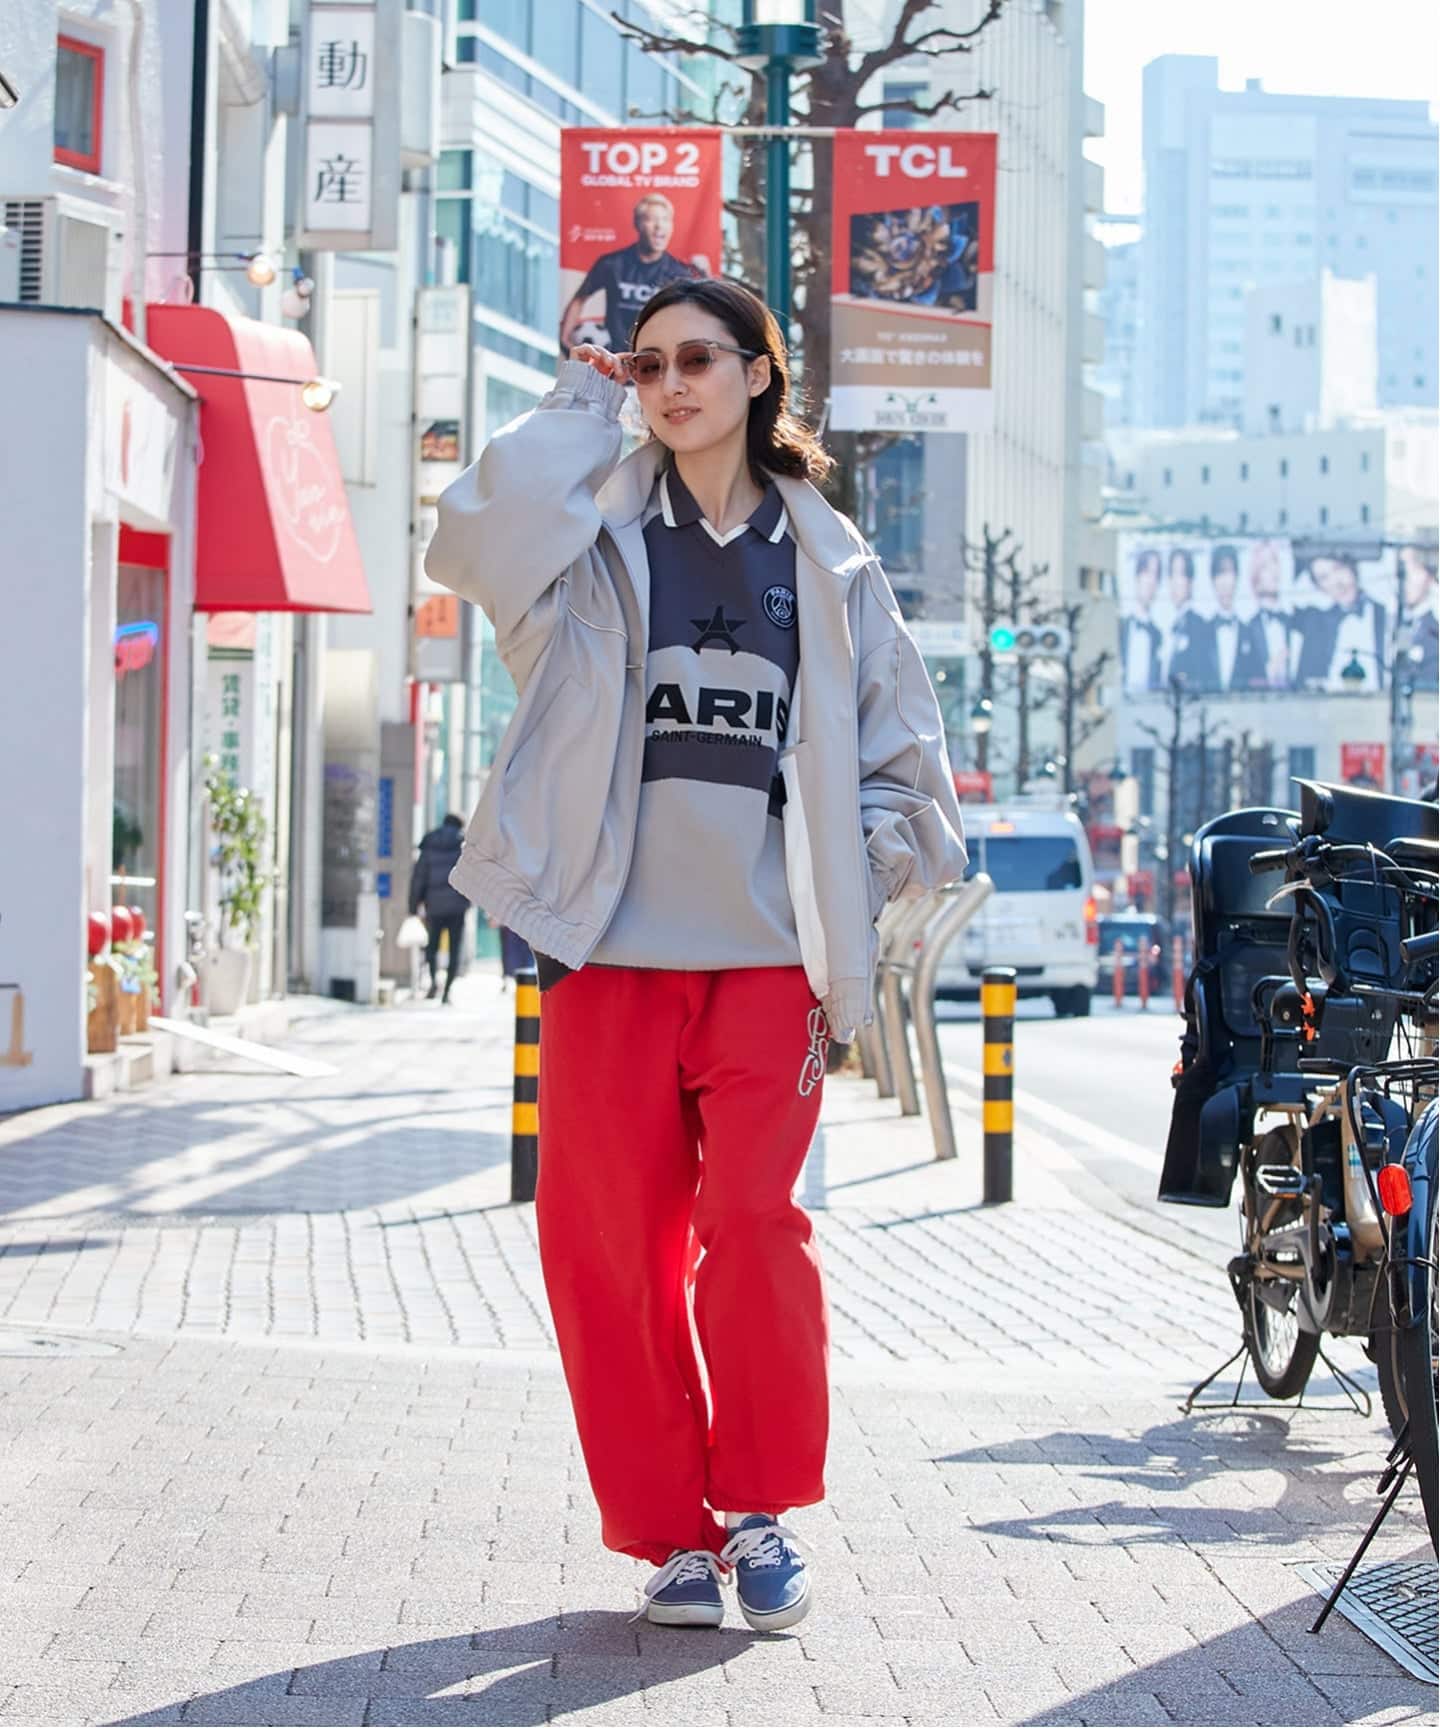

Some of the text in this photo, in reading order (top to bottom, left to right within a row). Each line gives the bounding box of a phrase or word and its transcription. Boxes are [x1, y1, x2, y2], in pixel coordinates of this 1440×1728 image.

[316, 40, 367, 203] 動産
[581, 142, 700, 175] TOP 2
[864, 144, 968, 178] TCL
[581, 174, 700, 188] GLOBAL TV BRAND
[618, 282, 661, 302] TC
[645, 682, 789, 743] ARIS
[651, 729, 763, 748] SAINT-GERMAIN
